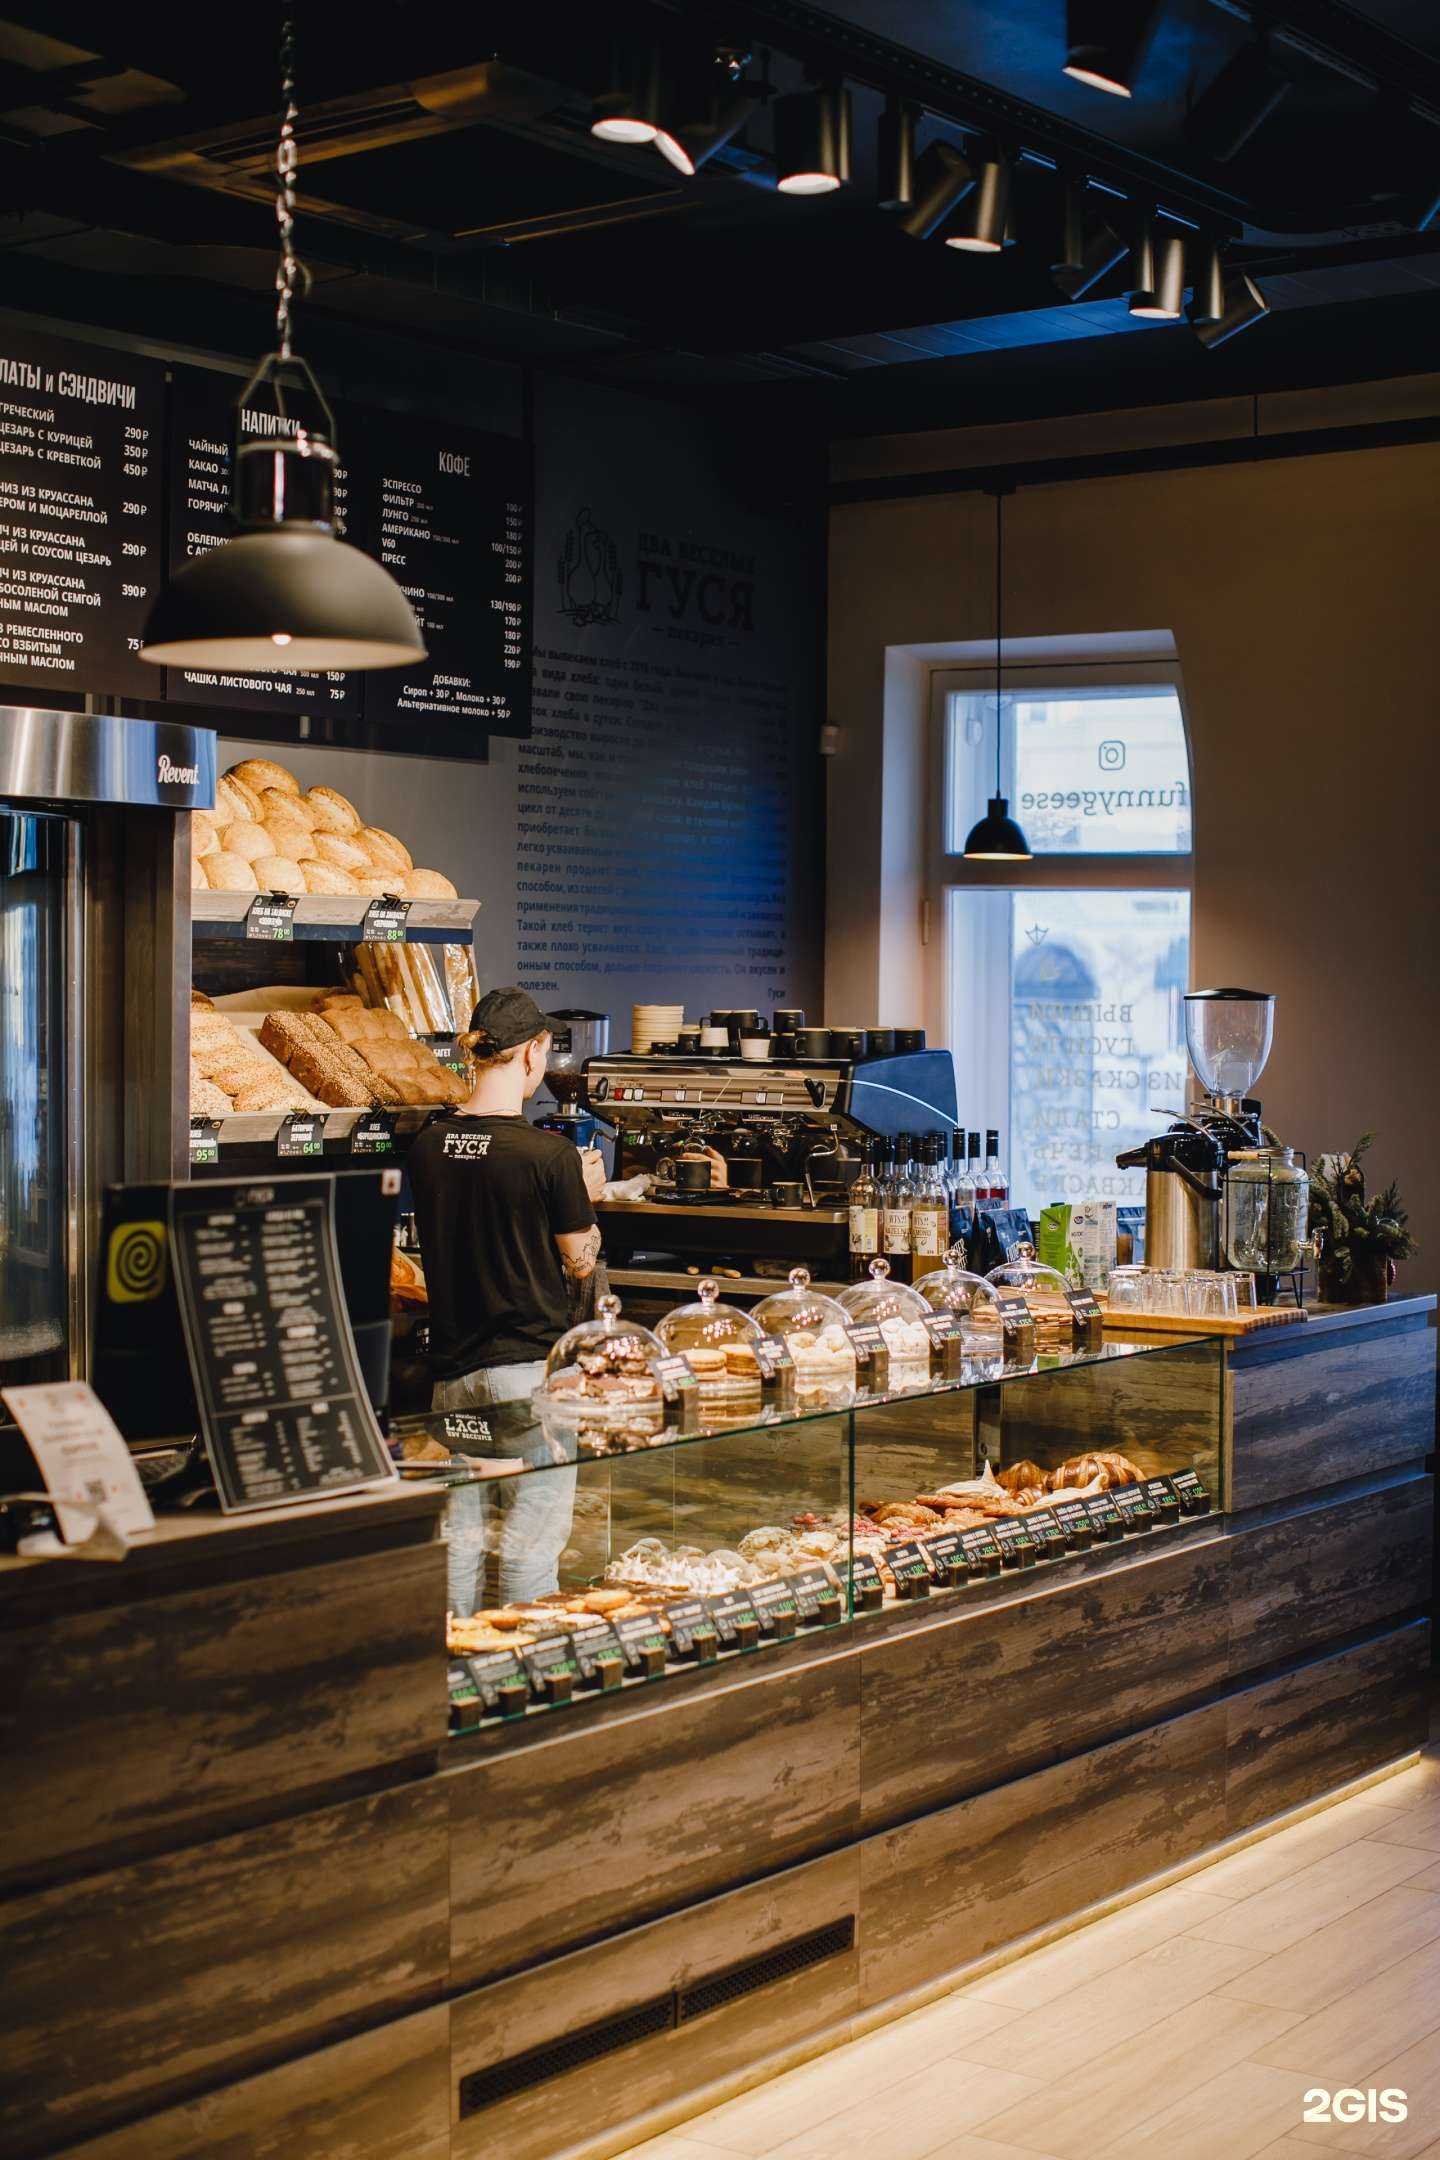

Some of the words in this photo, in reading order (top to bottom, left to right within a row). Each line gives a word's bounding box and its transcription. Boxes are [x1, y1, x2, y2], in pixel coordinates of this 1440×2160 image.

[46, 374, 53, 392] и
[58, 370, 136, 410] СЭНДВИЧИ
[241, 408, 301, 436] НАПИТКИ
[38, 430, 44, 440] С
[47, 431, 93, 449] КУРИЦЕЙ
[189, 440, 228, 456] ЧАЙНЫЙ
[37, 449, 44, 458] С
[47, 450, 101, 469] КРЕВЕТКОЙ
[189, 459, 218, 473] КАКАО
[439, 451, 470, 477] КОФЕ
[189, 478, 219, 494] МАТЧА
[382, 478, 422, 494] ЭСПРЕССО
[22, 486, 35, 497] ИЗ
[39, 488, 94, 507] КРУАССАНА
[382, 494, 414, 507] ФИЛЬТР
[29, 502, 36, 512] И
[40, 504, 108, 524] МОЦАРЕЛЛОЙ
[382, 508, 409, 521] ЛУНГО
[13, 526, 27, 538] ИЗ
[30, 529, 85, 548] КРУАССАНА
[187, 532, 232, 546] ОБЛЕПИ
[382, 523, 430, 540] АМЕРИКАНО
[187, 546, 193, 555] С
[382, 537, 396, 548] V60
[21, 543, 29, 554] И
[32, 545, 73, 560] СОУСОМ
[76, 552, 111, 566] ЦЕЗАРЬ
[382, 552, 407, 567] ПРЕСС
[13, 569, 26, 581] ИЗ
[30, 572, 85, 590] КРУАССАНА
[62, 591, 101, 606] СЕМГОЙ
[635, 559, 757, 632] ГУСЯ
[24, 601, 68, 617] МАСЛОМ
[7, 624, 83, 643] РЕМЕСЛЕННОГО
[13, 639, 61, 655] ВЗБИТЫМ
[31, 655, 75, 670] МАСЛОМ
[184, 671, 217, 685] ЧАШКА
[219, 676, 272, 692] ЛИСТОВОГО
[275, 683, 292, 694] ЧАЯ
[432, 675, 471, 688] ДОБАВКИ:
[403, 685, 427, 698] Сироп
[456, 691, 484, 703] Молоко
[397, 698, 460, 713] Альтернативное
[462, 707, 489, 716] молоко
[158, 754, 200, 785] Revent
[518, 783, 577, 800] используем
[518, 803, 543, 816] цикл
[545, 805, 557, 816] от
[517, 901, 580, 915] применения
[517, 920, 547, 933] Такой
[551, 921, 575, 934] хлеб
[517, 942, 548, 953] также
[551, 943, 580, 953] плохо
[517, 962, 552, 972] онным
[443, 1139, 490, 1155] ГУСЯ
